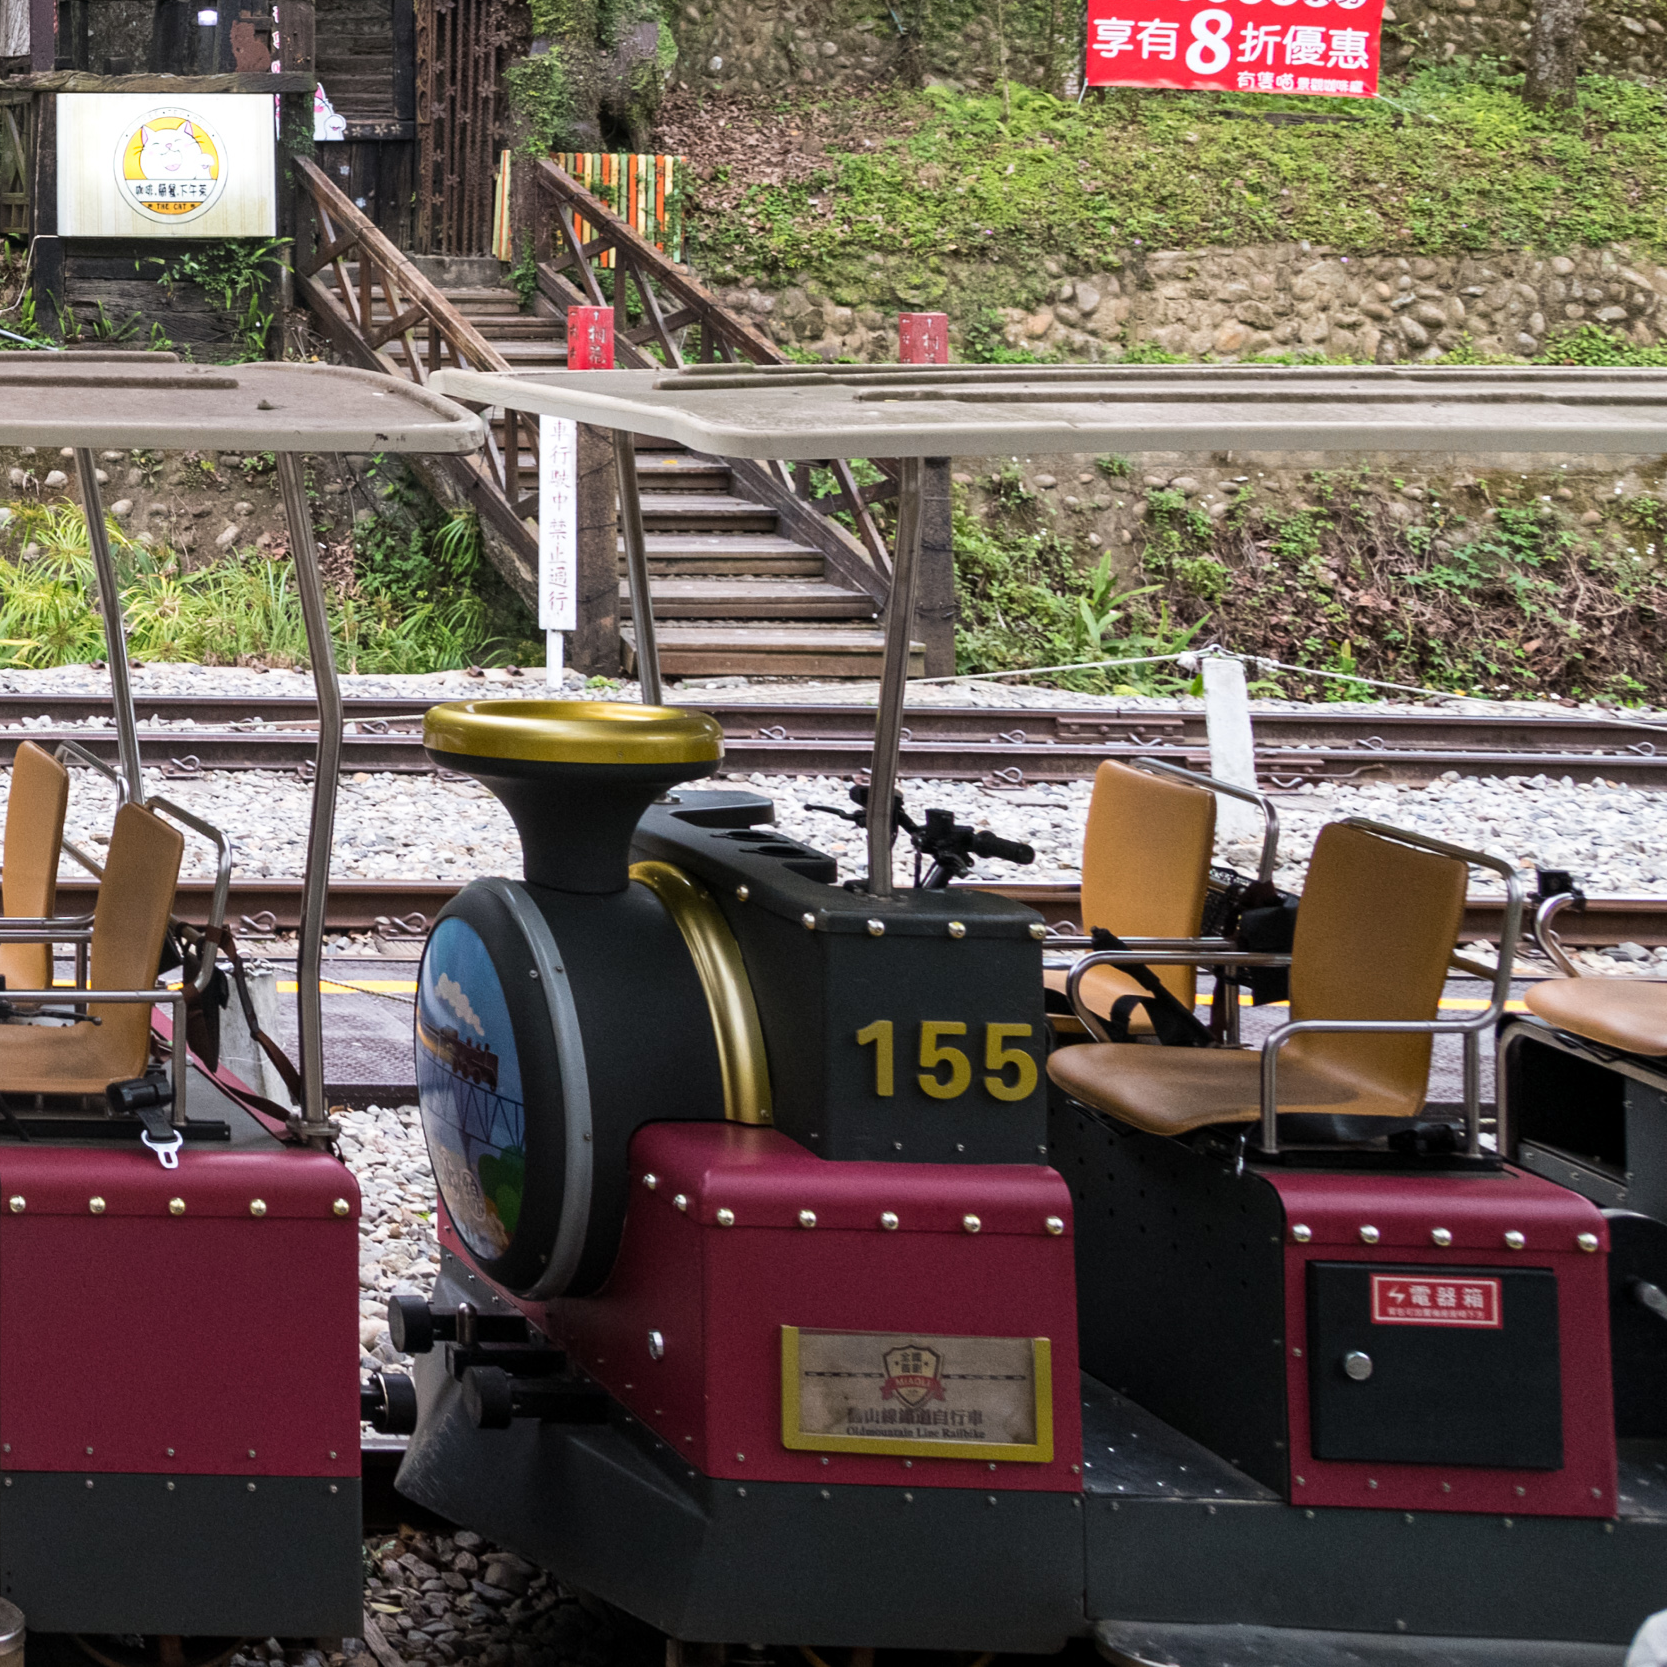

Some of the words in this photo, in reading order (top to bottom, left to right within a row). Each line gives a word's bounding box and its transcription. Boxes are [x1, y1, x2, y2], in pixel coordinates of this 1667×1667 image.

[1092, 8, 1370, 75] 享有8折優惠
[856, 1019, 1039, 1102] 155
[895, 1377, 933, 1387] MIAOLI
